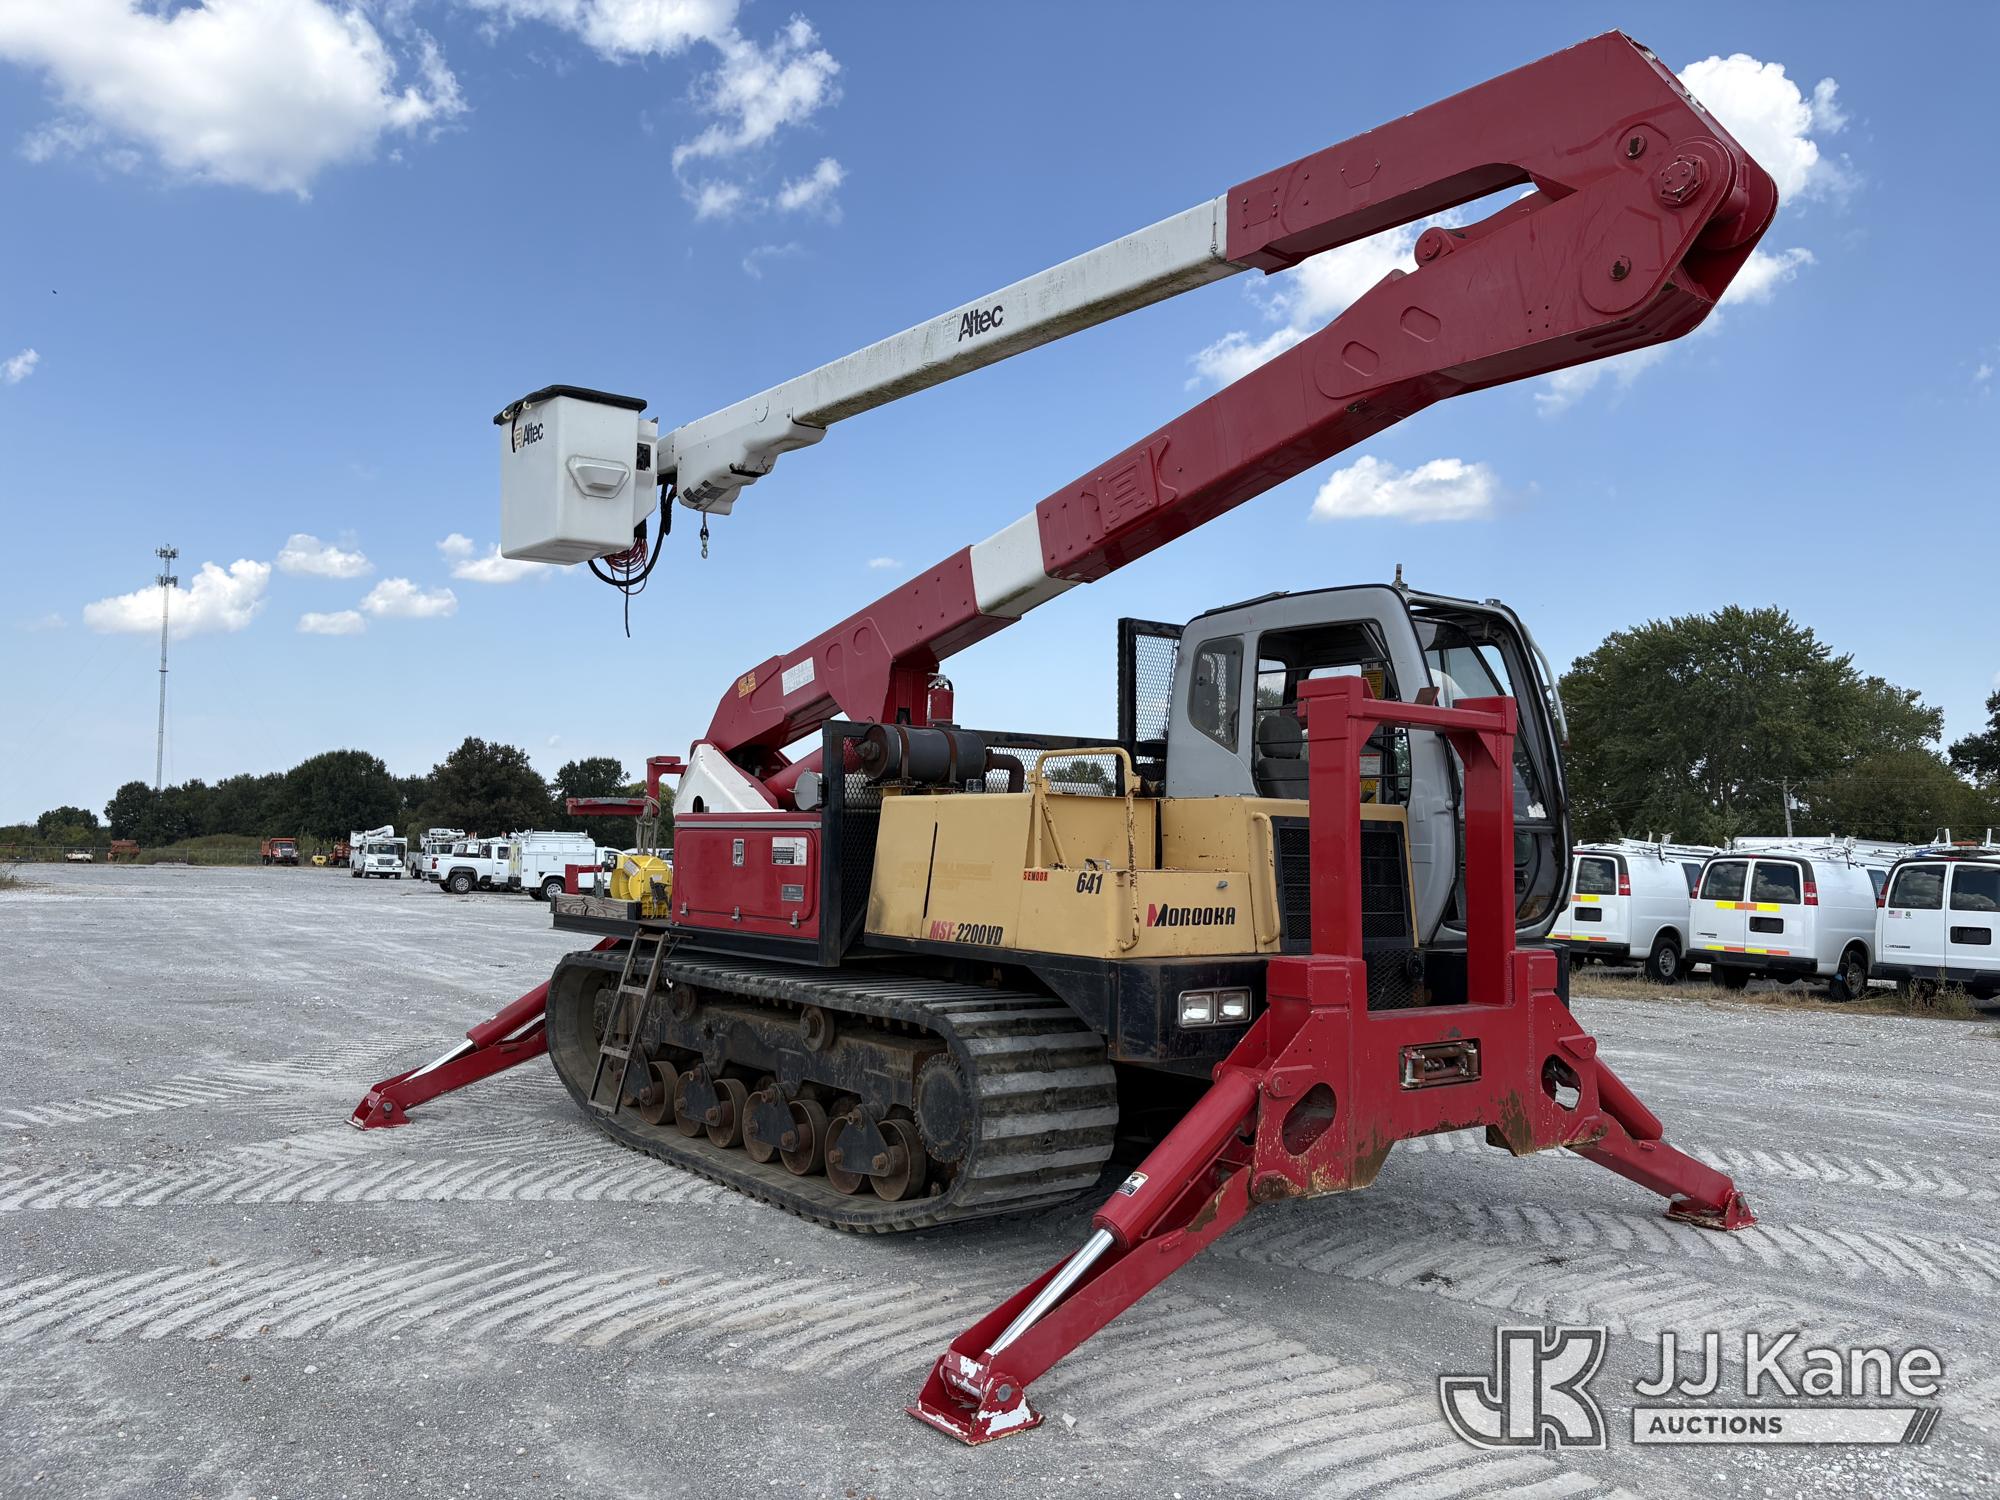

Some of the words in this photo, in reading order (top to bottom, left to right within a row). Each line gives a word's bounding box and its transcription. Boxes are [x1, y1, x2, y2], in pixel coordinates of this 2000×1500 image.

[958, 305, 1003, 342] Altec
[523, 422, 544, 447] Altec
[1076, 872, 1103, 895] 641
[929, 920, 1004, 946] MST-2200VD
